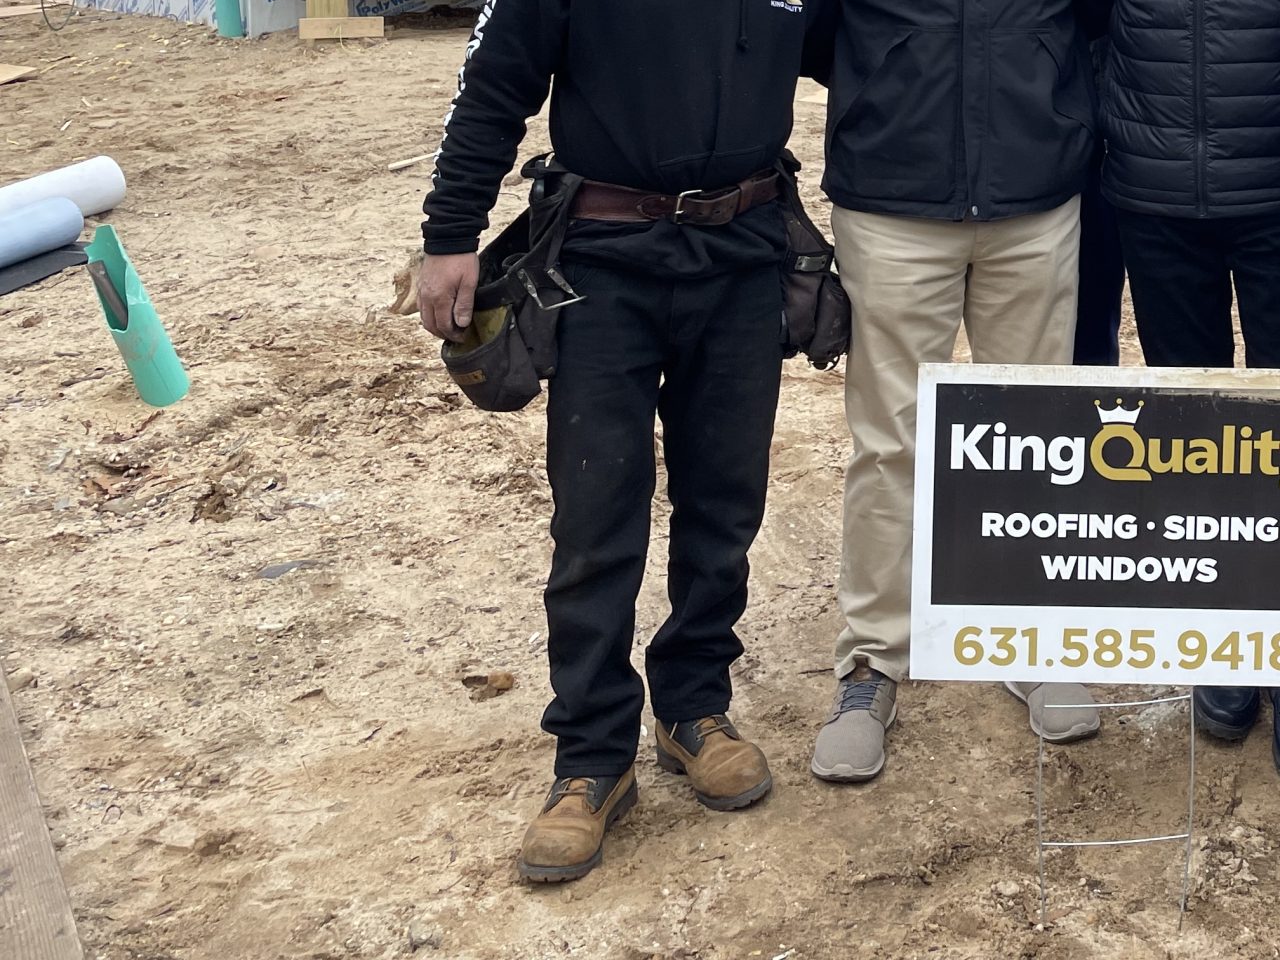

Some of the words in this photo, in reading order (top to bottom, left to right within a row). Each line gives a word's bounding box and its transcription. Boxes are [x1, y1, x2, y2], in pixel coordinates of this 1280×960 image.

[770, 0, 784, 8] KING
[981, 512, 1137, 539] ROOFING
[1163, 515, 1279, 542] SIDING
[1040, 555, 1219, 583] WINDOWS
